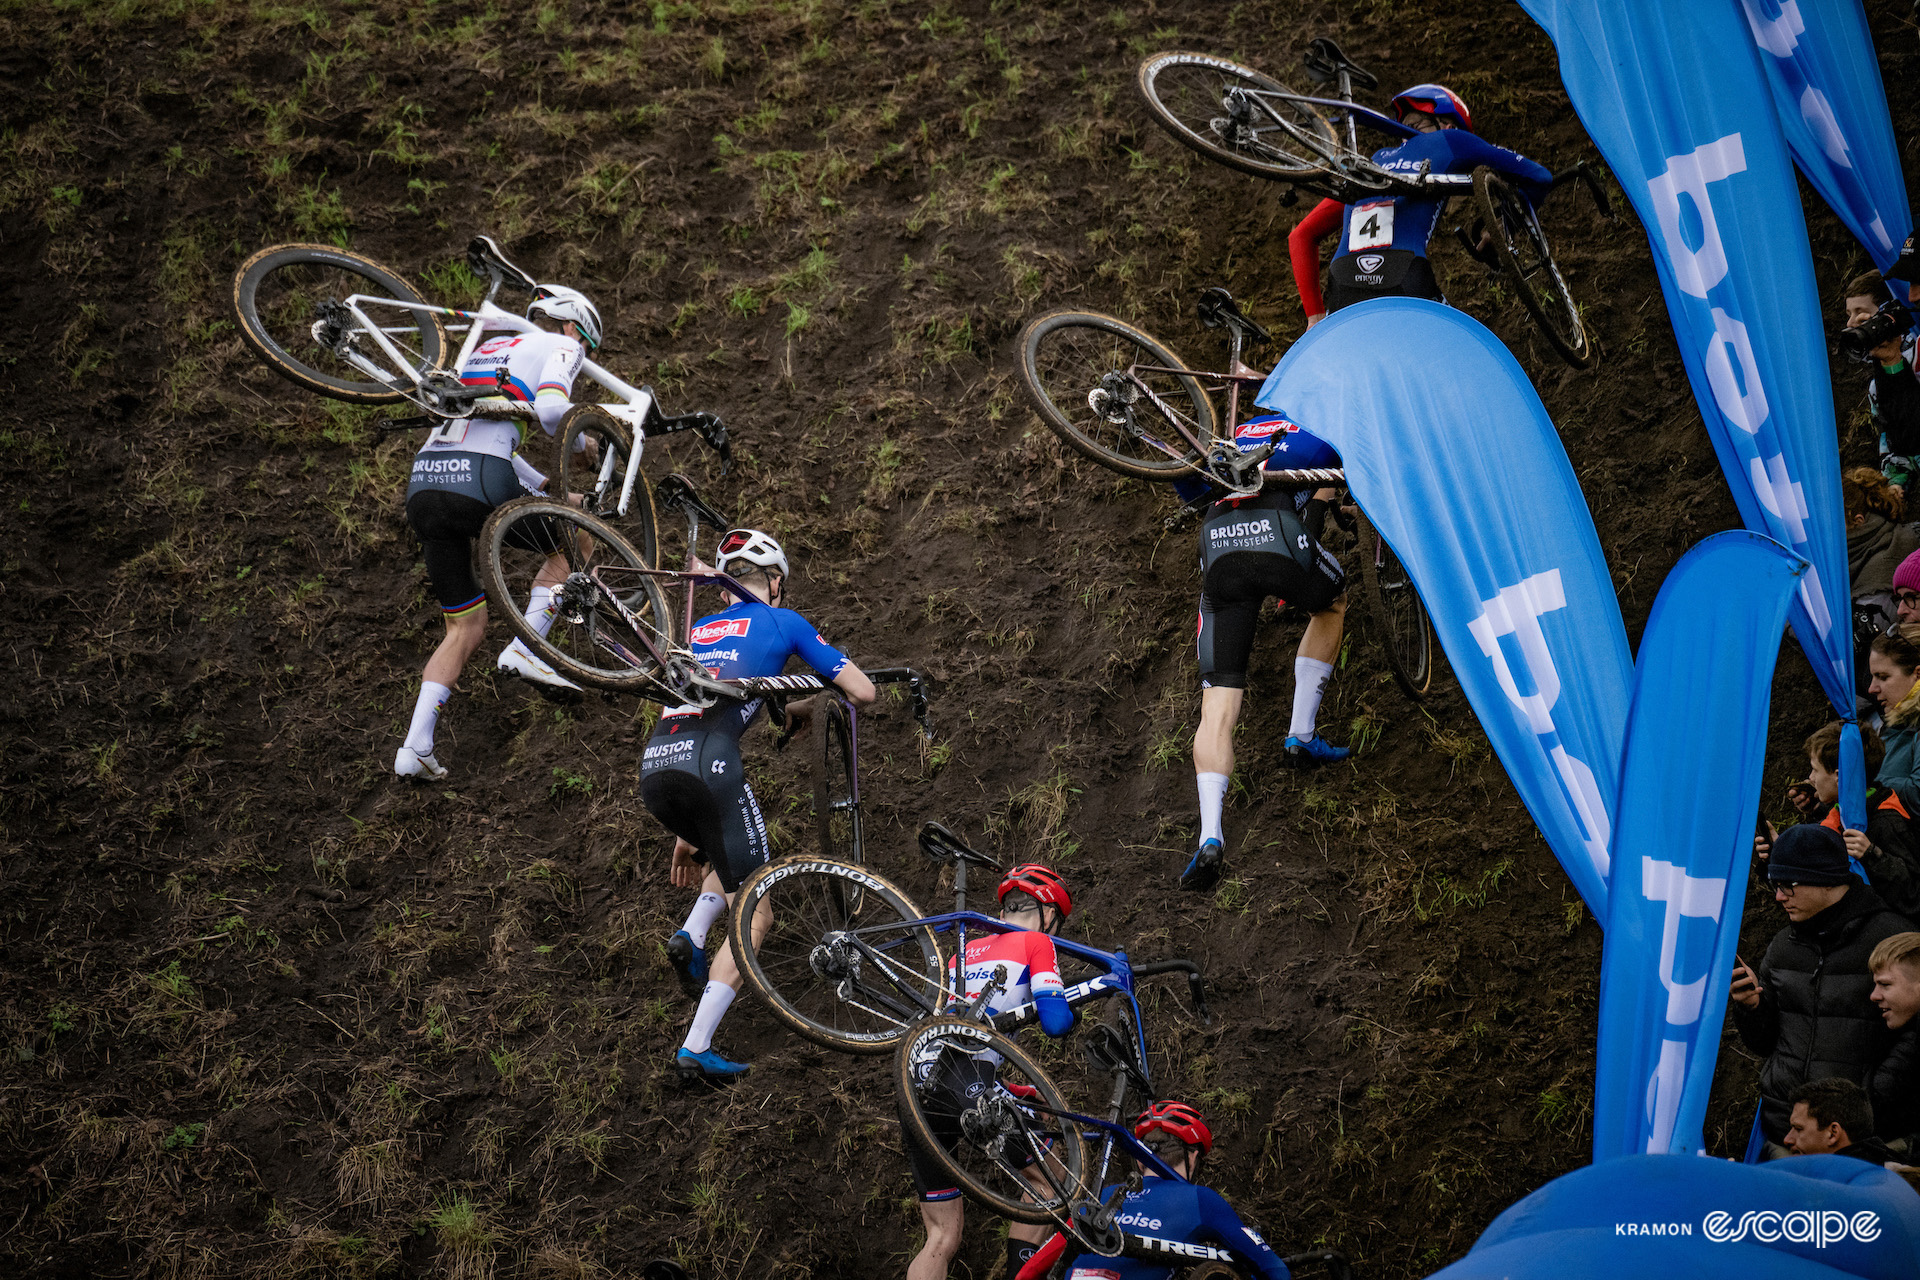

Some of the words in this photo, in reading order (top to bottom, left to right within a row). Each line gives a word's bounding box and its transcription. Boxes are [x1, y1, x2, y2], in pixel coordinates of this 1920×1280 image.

[1359, 213, 1381, 239] 4
[1355, 274, 1384, 285] energy
[570, 303, 595, 337] CANYON
[412, 458, 472, 473] BRUSTOR
[427, 473, 472, 484] SYSTEMS
[1210, 519, 1272, 540] BRUSTOR
[1211, 540, 1230, 549] SUN
[1232, 532, 1275, 548] SYSTEMS
[691, 622, 740, 640] Alpecin
[643, 739, 695, 760] BRUSTOR
[641, 759, 653, 771] SUN
[654, 752, 692, 768] SYSTEMS
[741, 806, 757, 846] WINDOWS
[755, 863, 885, 899] BONTRAGER
[929, 955, 940, 967] 55
[1006, 976, 1107, 1022] TEK
[845, 1030, 898, 1041] AEOLUS
[1134, 1234, 1234, 1263] TREK
